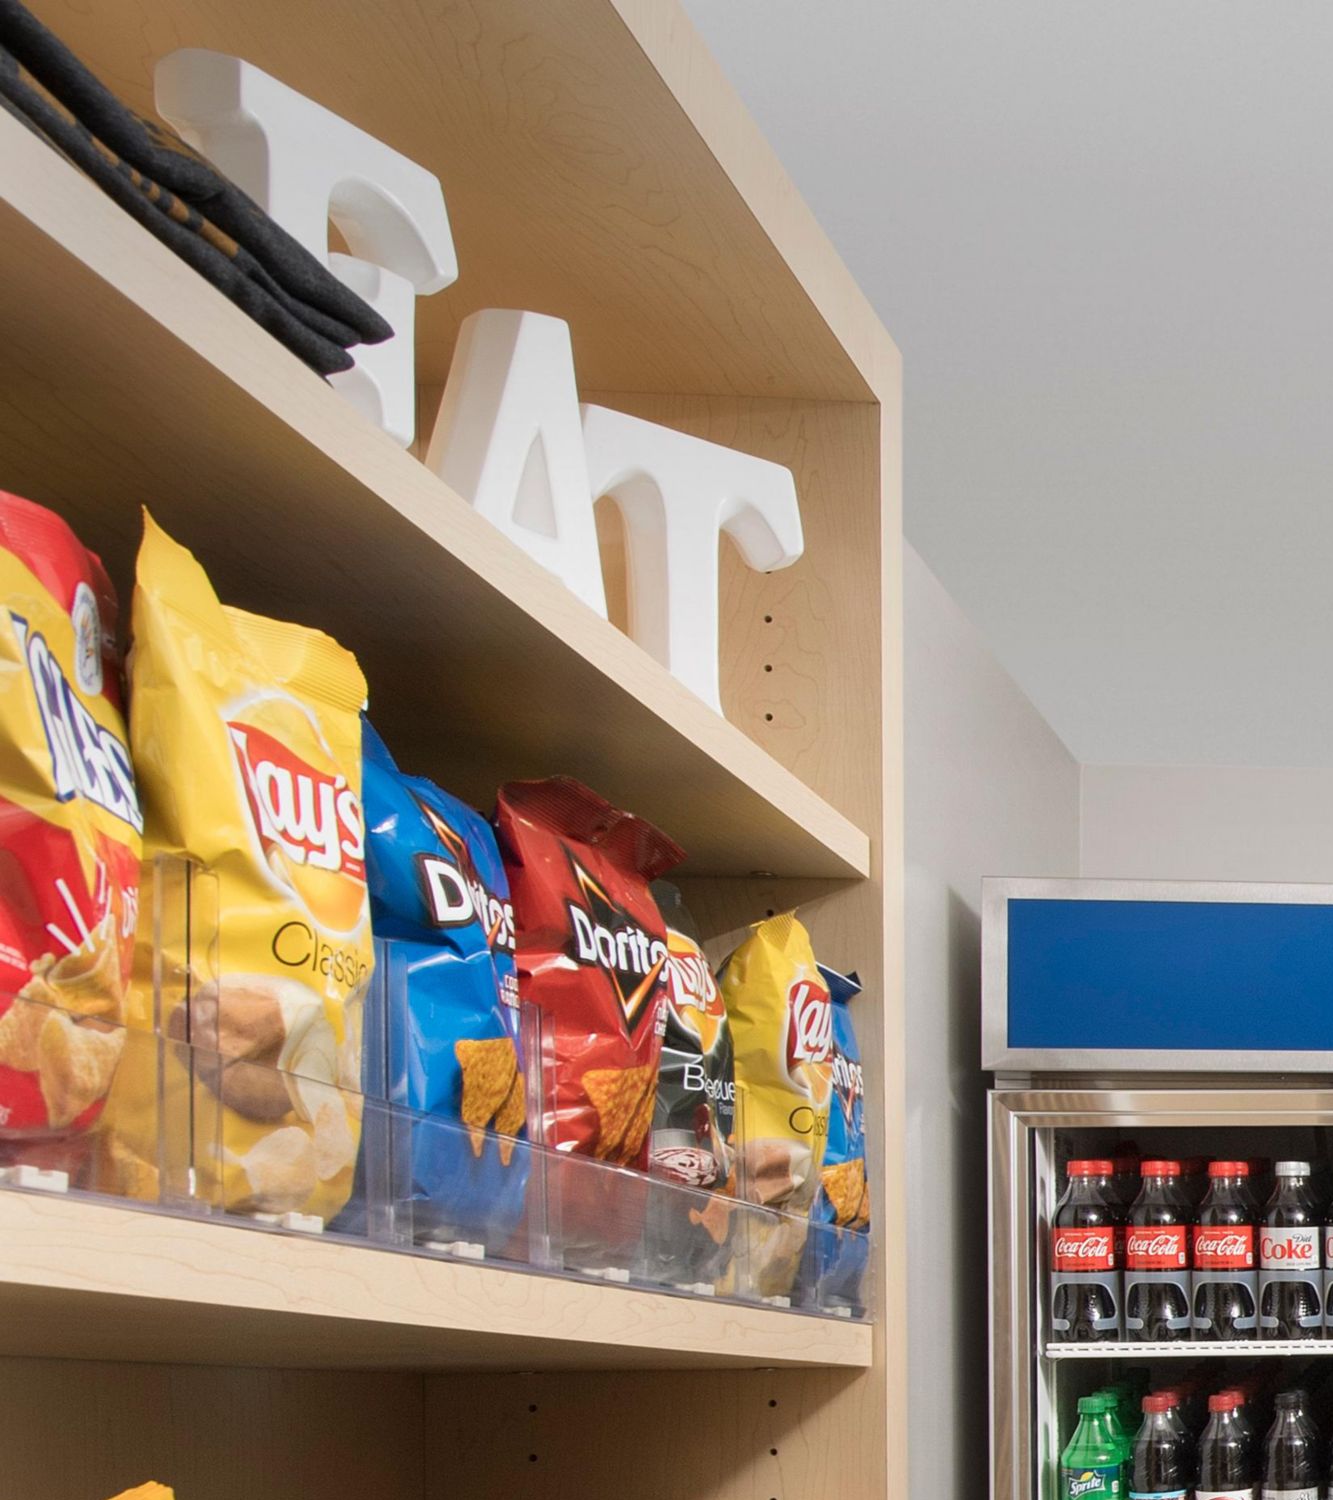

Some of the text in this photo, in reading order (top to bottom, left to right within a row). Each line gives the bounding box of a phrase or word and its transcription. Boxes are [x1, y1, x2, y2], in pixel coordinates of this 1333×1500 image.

[230, 727, 366, 871] Lay's
[1055, 1235, 1109, 1258] Coca-Cola
[1127, 1235, 1180, 1257] Coca-Cola
[1195, 1235, 1248, 1257] Coca-Cola
[1261, 1238, 1313, 1260] Coke
[1070, 1476, 1102, 1495] Sprite
